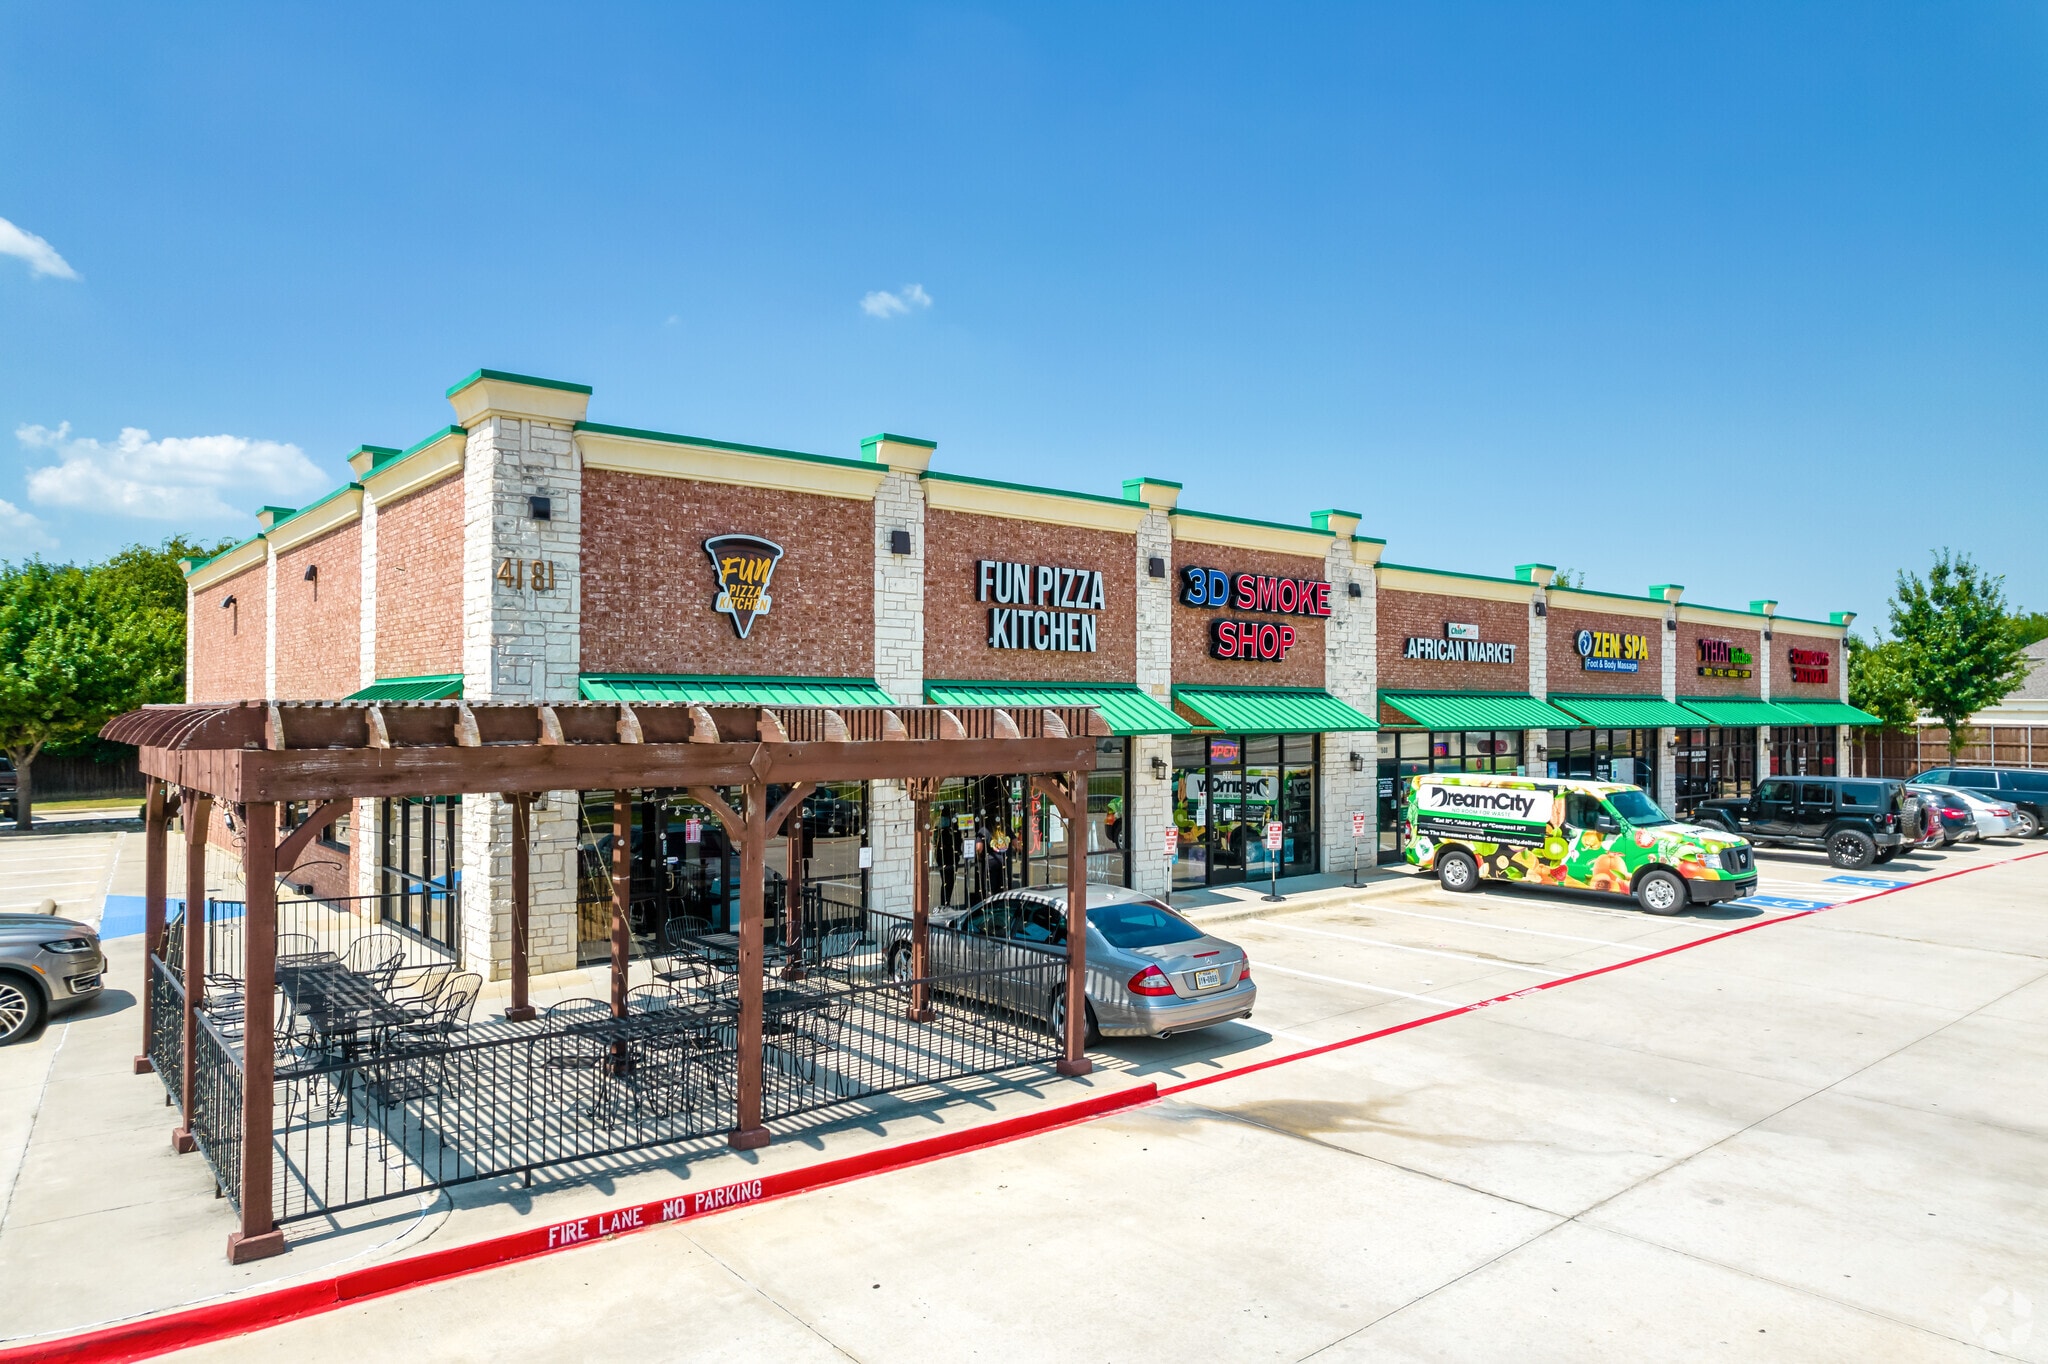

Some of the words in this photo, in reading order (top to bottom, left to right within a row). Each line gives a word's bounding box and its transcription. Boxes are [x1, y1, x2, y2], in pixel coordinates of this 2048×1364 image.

[496, 558, 554, 591] 4181
[979, 560, 1031, 606] FUN
[1037, 566, 1106, 610] PIZZA
[719, 596, 768, 611] KITCHEN
[729, 584, 762, 598] PIZZA
[1186, 568, 1230, 607] 3D
[1236, 573, 1332, 616] SMOKE
[993, 608, 1097, 652] KITCHEN
[1217, 621, 1297, 660] SHOP
[1407, 637, 1464, 660] AFRICAN
[1467, 641, 1516, 664] MARKET
[1593, 631, 1620, 659] ZEN
[1624, 634, 1648, 660] SPA
[1702, 639, 1729, 662] THAI
[1587, 659, 1599, 669] Foot
[1604, 660, 1617, 671] Body
[1617, 661, 1637, 672] Massage
[1431, 787, 1535, 817] DreamCity
[1440, 831, 1468, 839] Movement
[548, 1219, 589, 1247] FIRE
[600, 1207, 644, 1235] LANE
[662, 1198, 686, 1221] NO
[695, 1179, 762, 1212] PARKING
